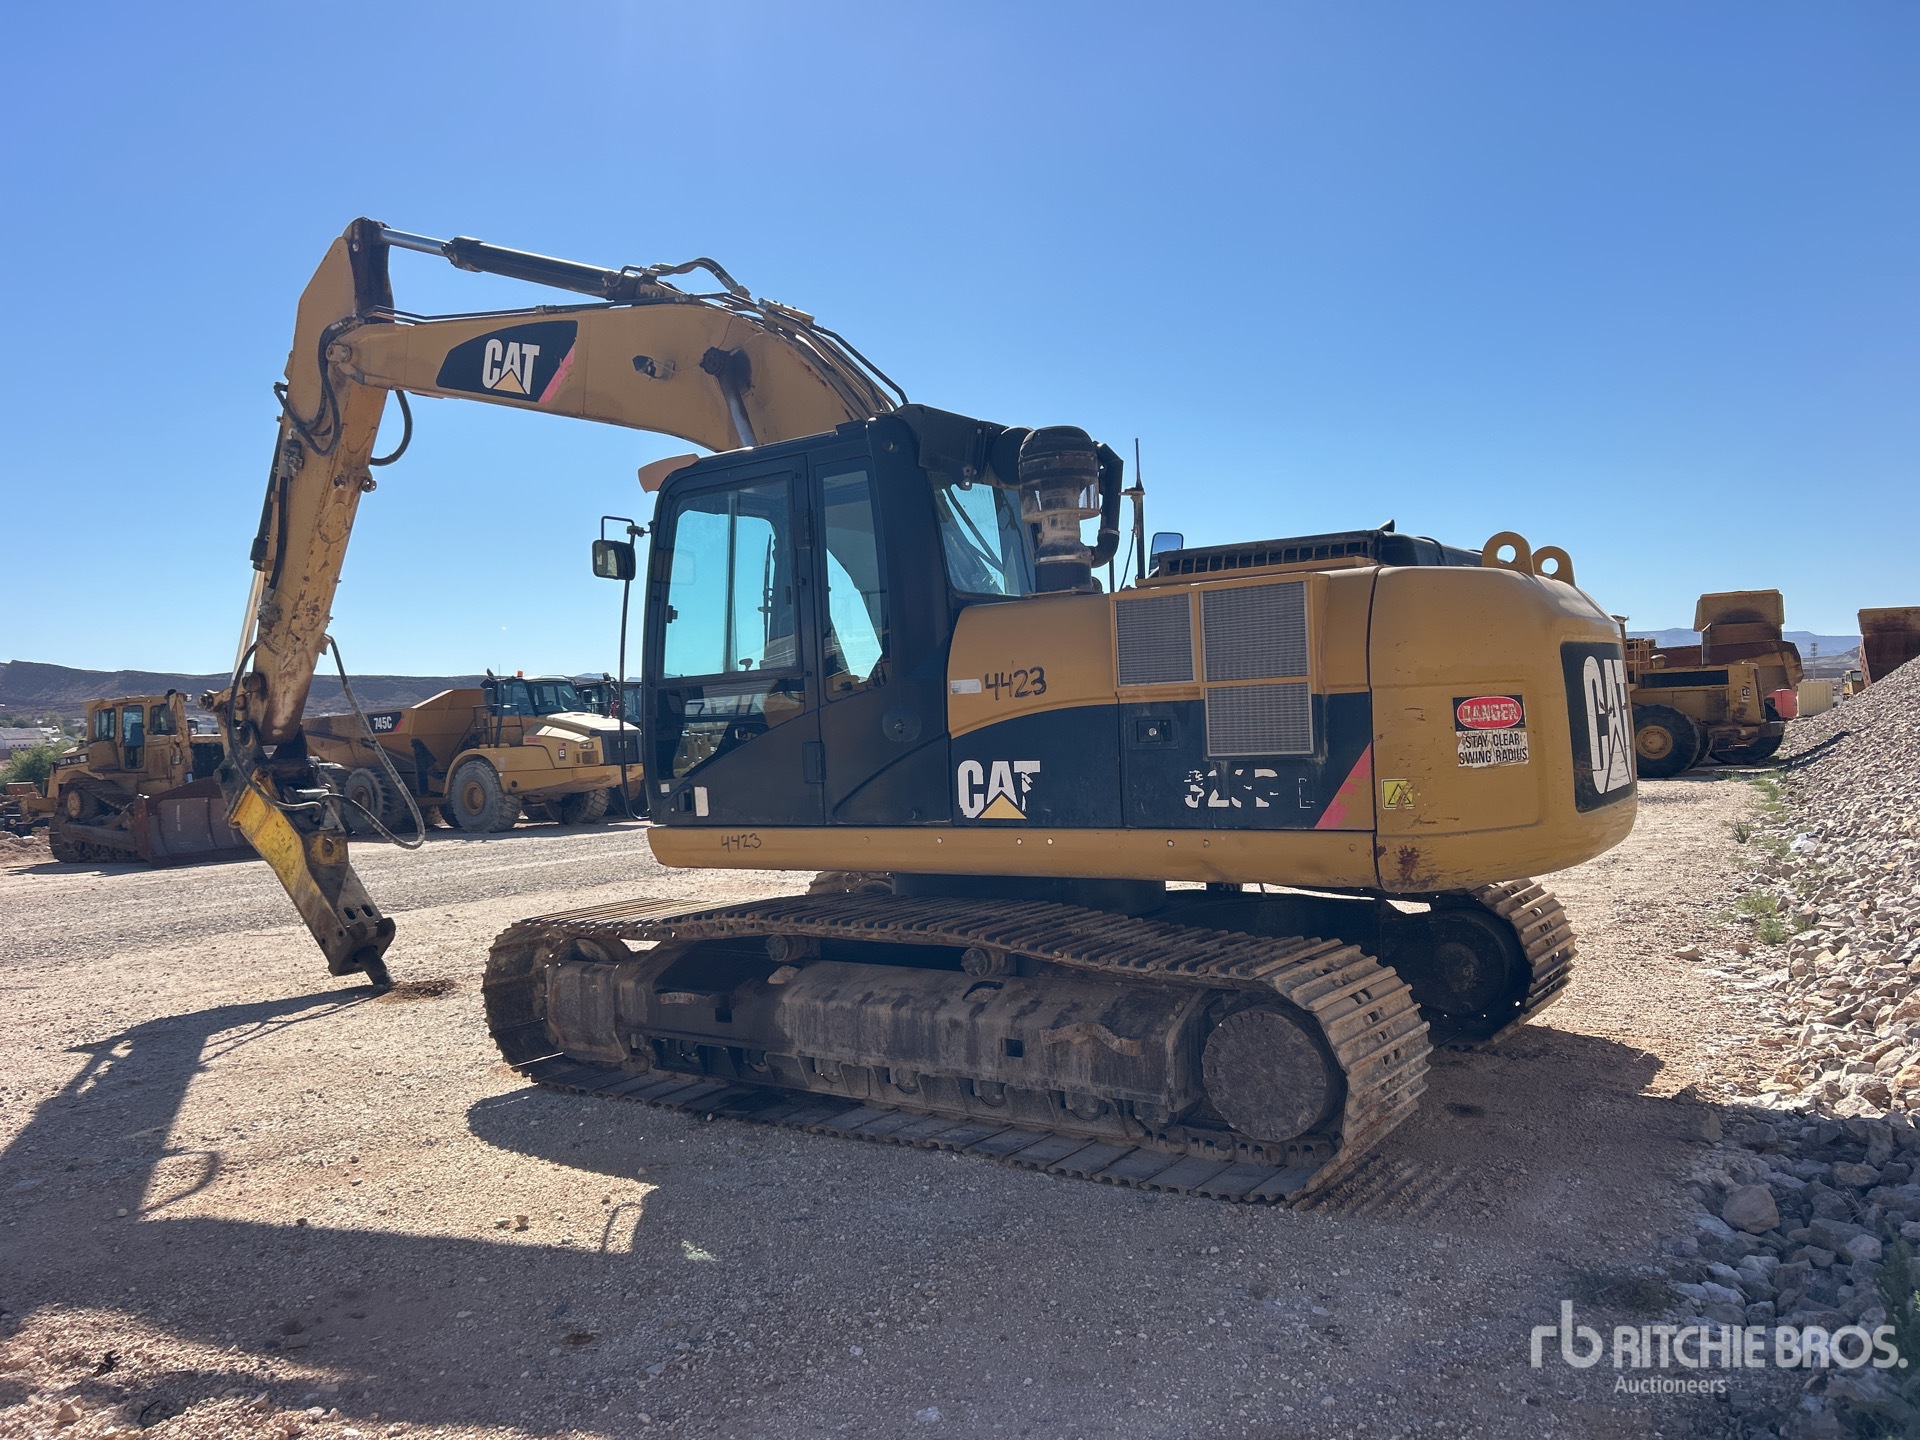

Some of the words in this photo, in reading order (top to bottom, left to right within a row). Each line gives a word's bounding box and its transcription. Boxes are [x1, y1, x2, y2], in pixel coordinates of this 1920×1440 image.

[482, 338, 540, 395] CAT
[984, 666, 1047, 701] 4423
[1462, 703, 1519, 722] DANGER
[373, 716, 392, 730] 745C
[1583, 655, 1632, 795] CAT
[1465, 735, 1488, 749] STAY
[1493, 733, 1520, 747] CLEAR
[1458, 750, 1492, 765] SWING
[1495, 747, 1527, 762] RADIUS
[957, 759, 1041, 819] CAT
[721, 833, 762, 853] 4423
